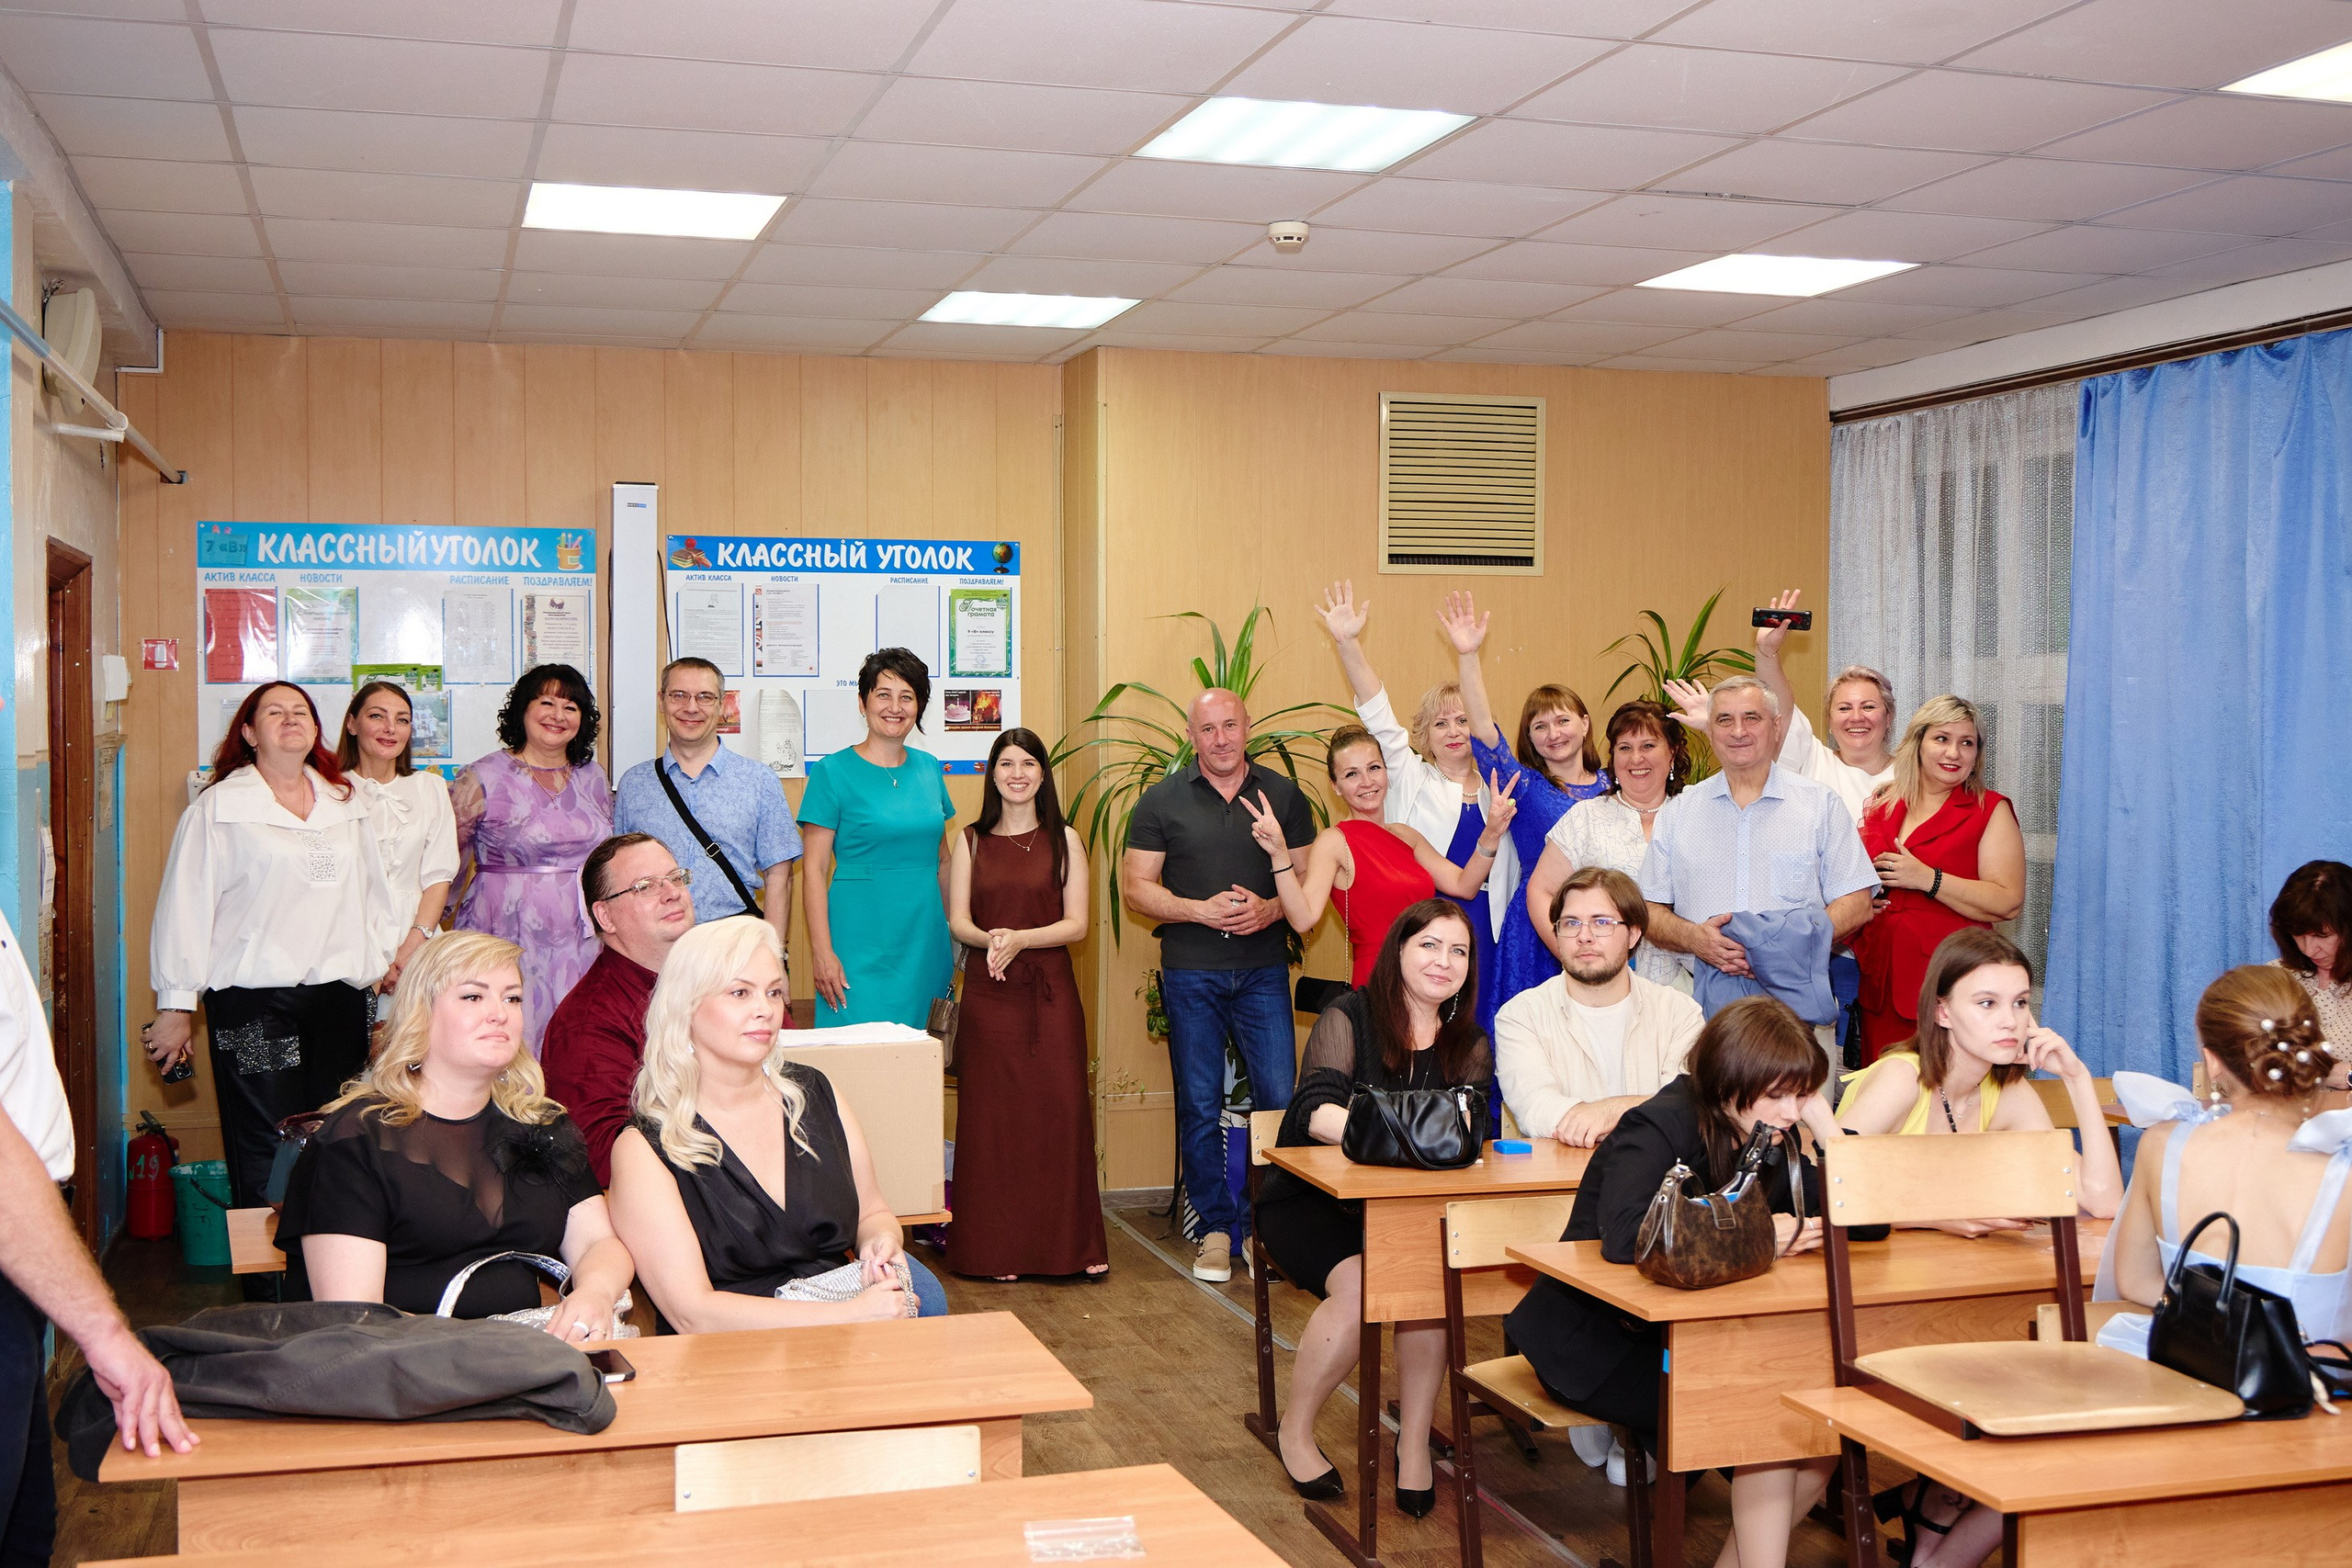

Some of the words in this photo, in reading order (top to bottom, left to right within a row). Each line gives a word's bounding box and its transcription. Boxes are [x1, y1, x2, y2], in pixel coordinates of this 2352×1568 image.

[206, 539, 216, 552] 7
[257, 530, 427, 564] КЛАССНЫЙ
[431, 535, 542, 568] УГОЛОК
[717, 540, 867, 569] КЛАССНЫЙ
[876, 544, 975, 571] УГОЛОК
[204, 571, 236, 581] АКТИВ
[239, 572, 276, 582] КЛАССА
[300, 573, 343, 583] НОВОСТИ
[449, 575, 510, 585] РАСПИСАНИЕ
[523, 576, 593, 587] ПОЗДРАВЛЯЕМ!
